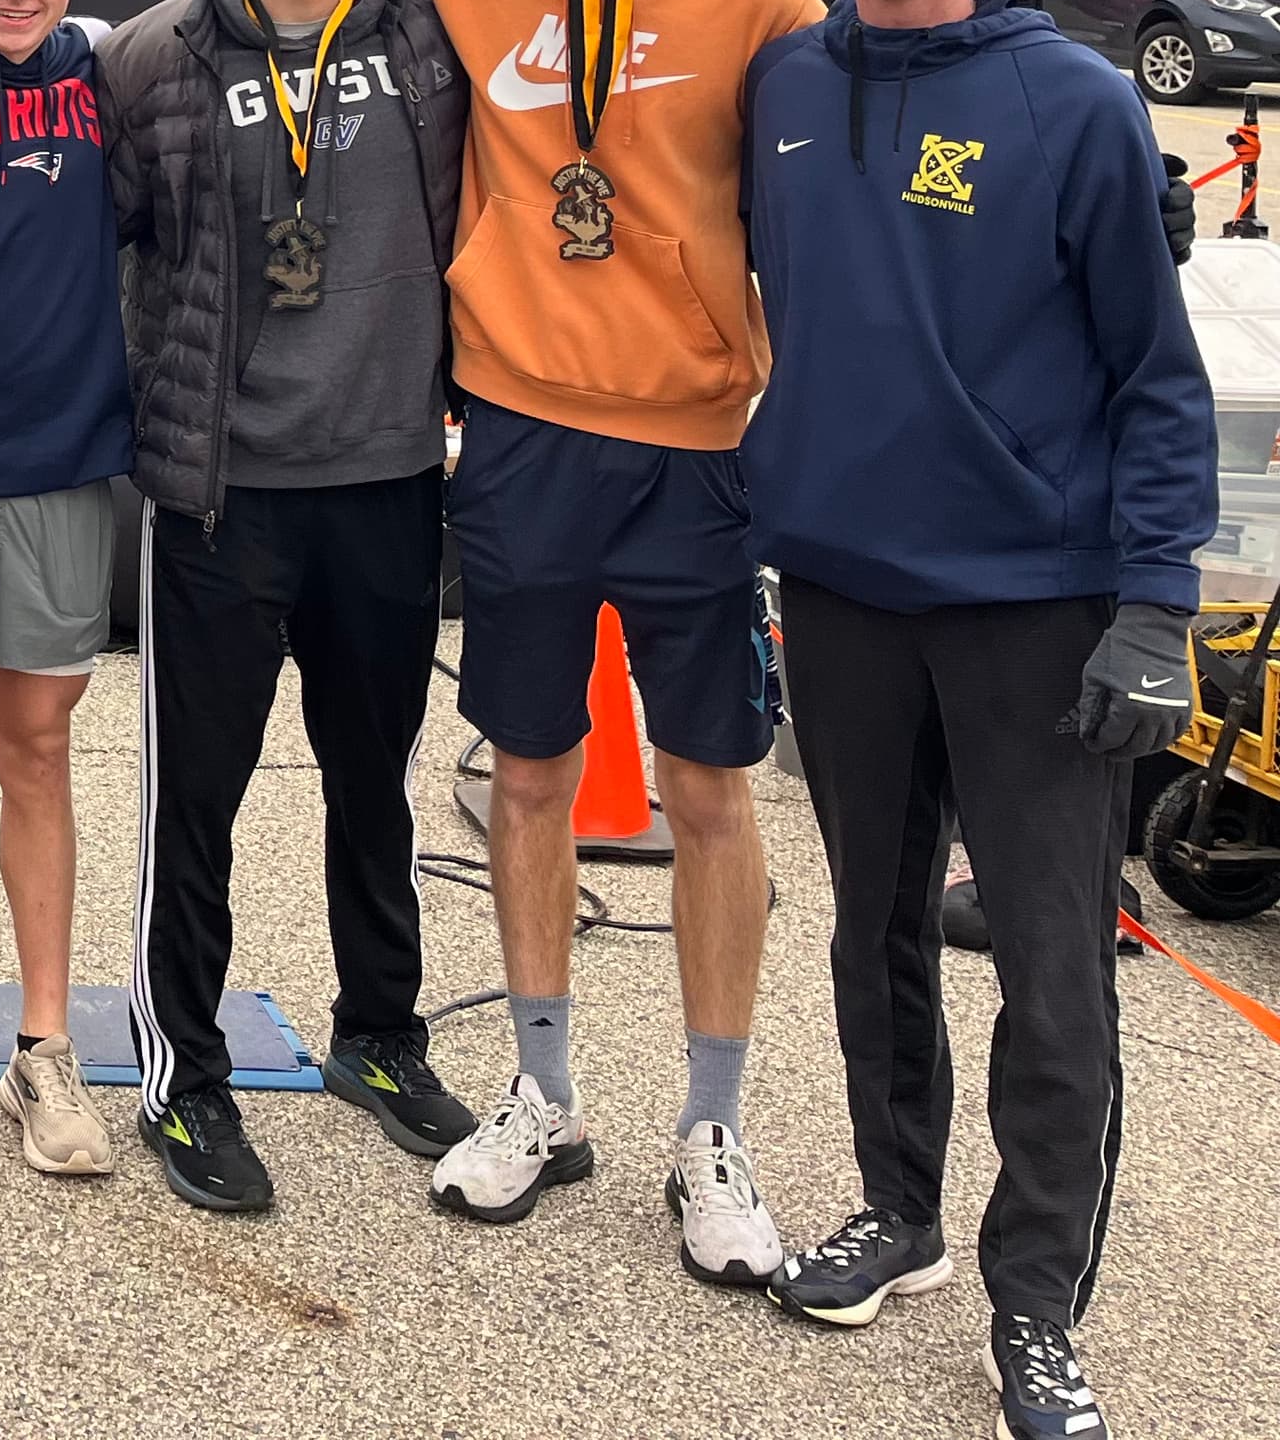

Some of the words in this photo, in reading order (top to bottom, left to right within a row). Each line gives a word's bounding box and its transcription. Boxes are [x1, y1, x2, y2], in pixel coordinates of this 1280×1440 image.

[518, 13, 660, 74] NE
[553, 167, 582, 192] JUSTIF
[595, 179, 613, 197] PIE
[901, 191, 976, 216] HUDSONVILLE
